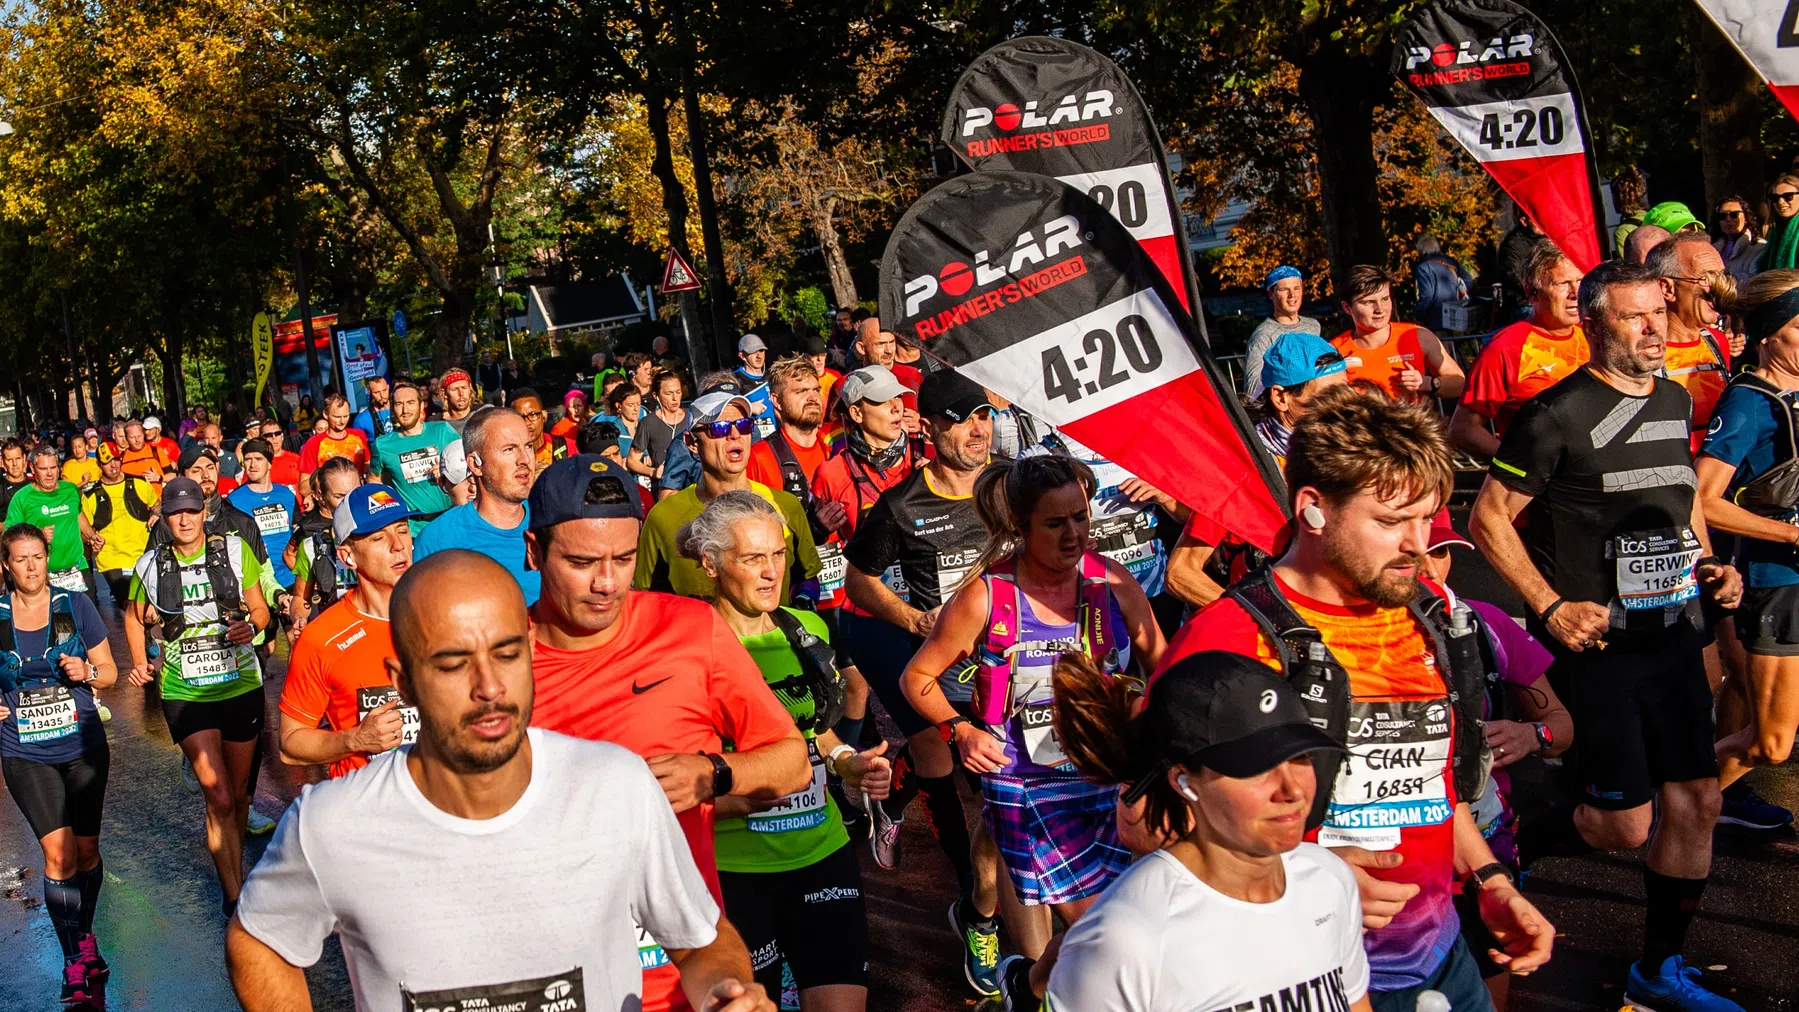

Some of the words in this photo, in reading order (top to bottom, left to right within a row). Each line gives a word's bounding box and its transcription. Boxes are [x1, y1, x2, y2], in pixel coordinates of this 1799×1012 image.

[1406, 34, 1534, 70] POLAR
[1409, 66, 1483, 87] RUNNER'S
[1486, 64, 1530, 77] WORLD
[962, 89, 1114, 138] POLAR
[1479, 106, 1564, 150] 4:20
[967, 134, 1054, 158] RUNNER'S
[1057, 126, 1108, 145] WORLD
[905, 214, 1083, 317] POLAR
[915, 283, 1022, 342] RUNNER'S
[1023, 258, 1083, 294] WORLD
[1041, 314, 1164, 404] 4:20
[409, 459, 433, 469] DAVID
[260, 513, 283, 522] DANIEL
[1621, 538, 1647, 554] tcs
[1649, 538, 1679, 547] CONSULTANCY
[1683, 540, 1699, 548] TATA
[940, 554, 963, 567] tcs
[1629, 551, 1695, 574] GERWIN
[819, 569, 842, 582] 15607
[1621, 592, 1677, 609] AMSTERDAM
[1094, 607, 1104, 645] AONIJIE
[182, 642, 198, 652] tcs
[336, 628, 367, 651] hummel
[187, 649, 233, 664] CAROLA
[196, 663, 227, 675] 15483
[186, 675, 224, 687] AMSTERDAM
[19, 692, 31, 706] tcs
[1301, 692, 1328, 704] salomon
[21, 702, 71, 719] SANDRA
[31, 717, 63, 730] 13435
[1425, 723, 1448, 735] TATA
[20, 730, 60, 743] AMSTERDAM
[1366, 746, 1425, 771] CIAN
[1363, 777, 1424, 799] 16859
[751, 815, 814, 832] AMSTERDAM
[804, 886, 859, 903] PIPEXPERTS
[752, 946, 778, 966] SPORT
[461, 998, 490, 1009] TATA
[540, 998, 578, 1012] TATA
